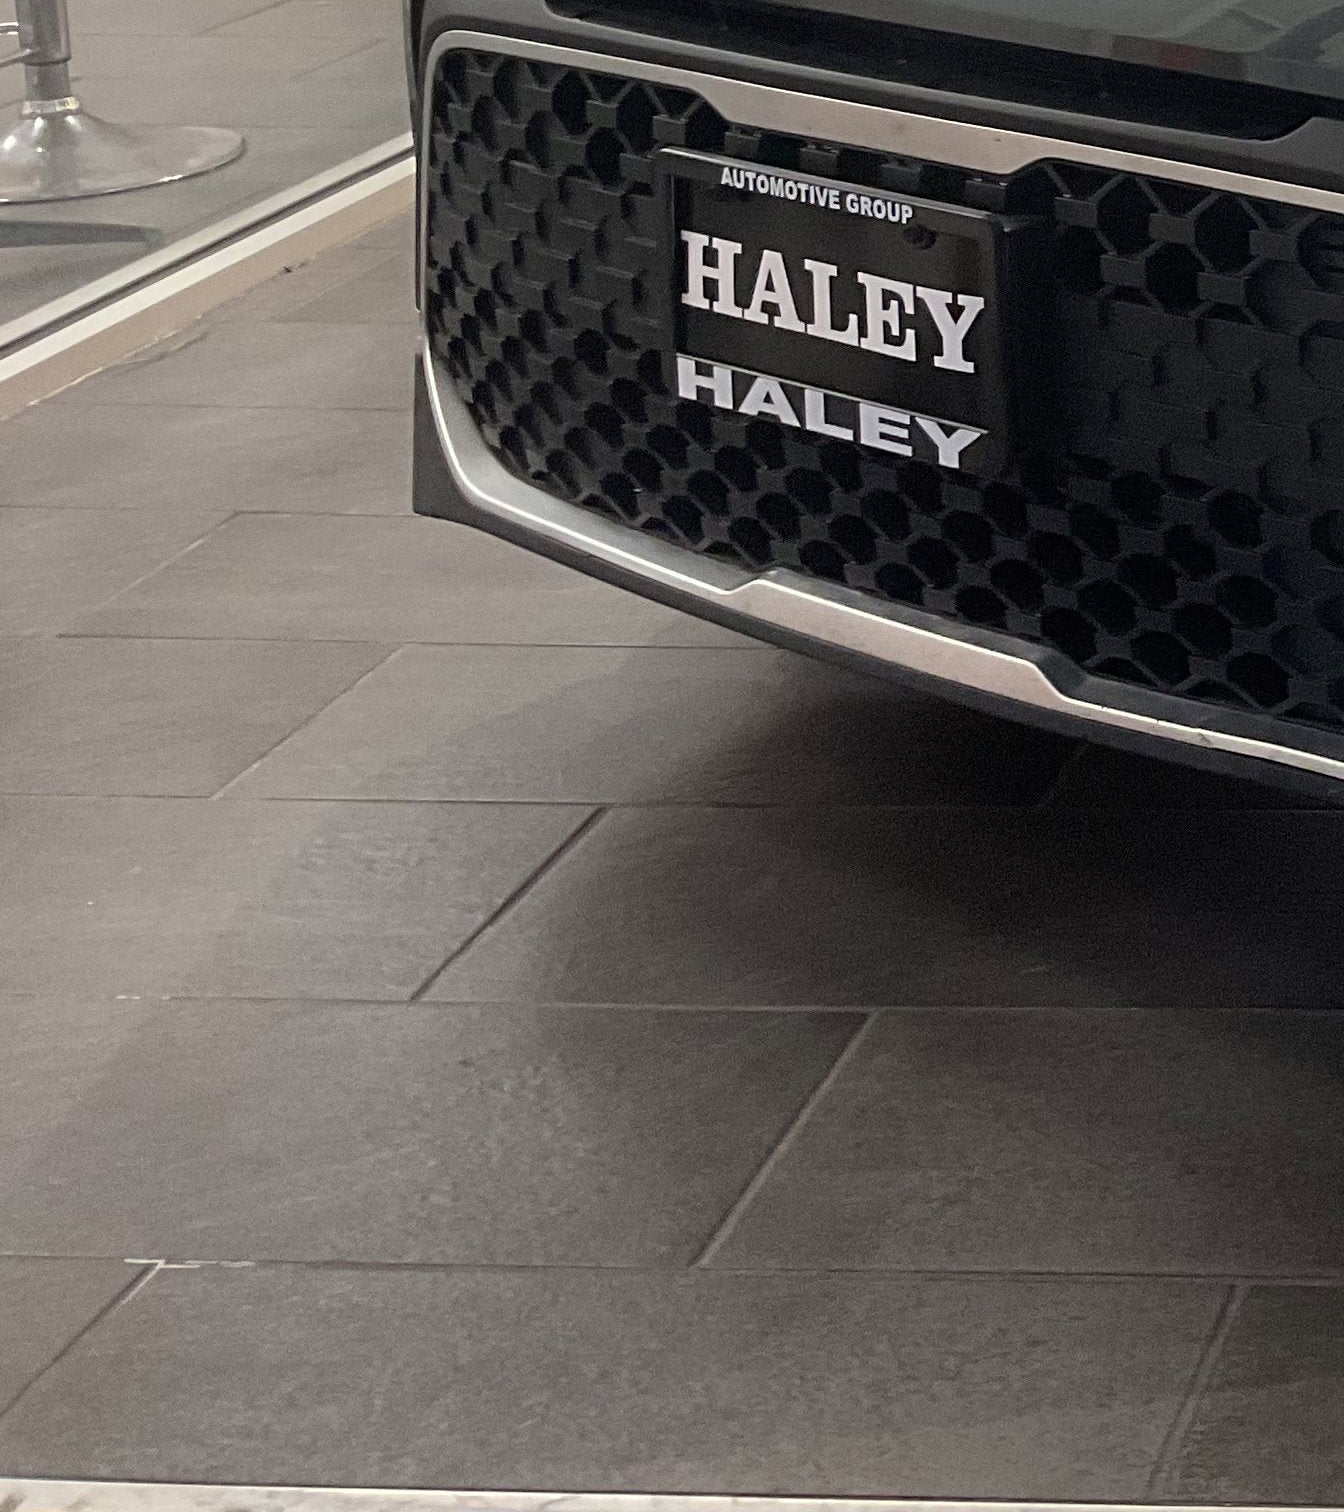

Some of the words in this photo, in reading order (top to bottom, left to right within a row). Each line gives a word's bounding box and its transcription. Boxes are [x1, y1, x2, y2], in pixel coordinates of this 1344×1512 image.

[721, 166, 841, 211] AUTOMOTIVE
[846, 193, 913, 225] GROUP
[680, 229, 985, 374] HALEY
[676, 356, 982, 470] HALEY
